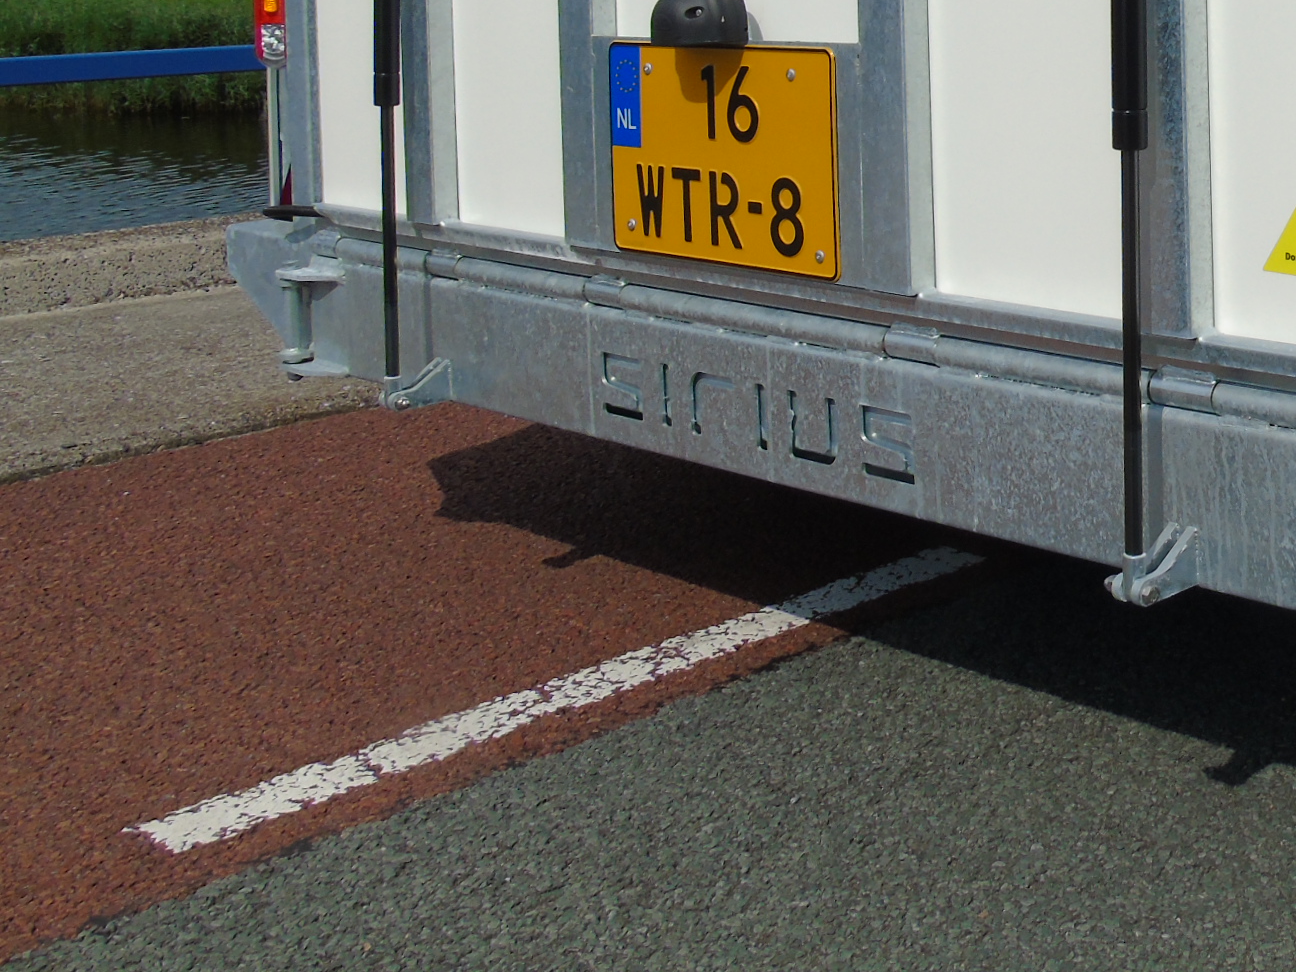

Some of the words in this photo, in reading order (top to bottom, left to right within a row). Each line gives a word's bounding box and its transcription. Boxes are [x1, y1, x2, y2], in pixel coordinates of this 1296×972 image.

[616, 108, 637, 130] NL
[700, 64, 759, 143] 16
[636, 163, 804, 257] WTR-8
